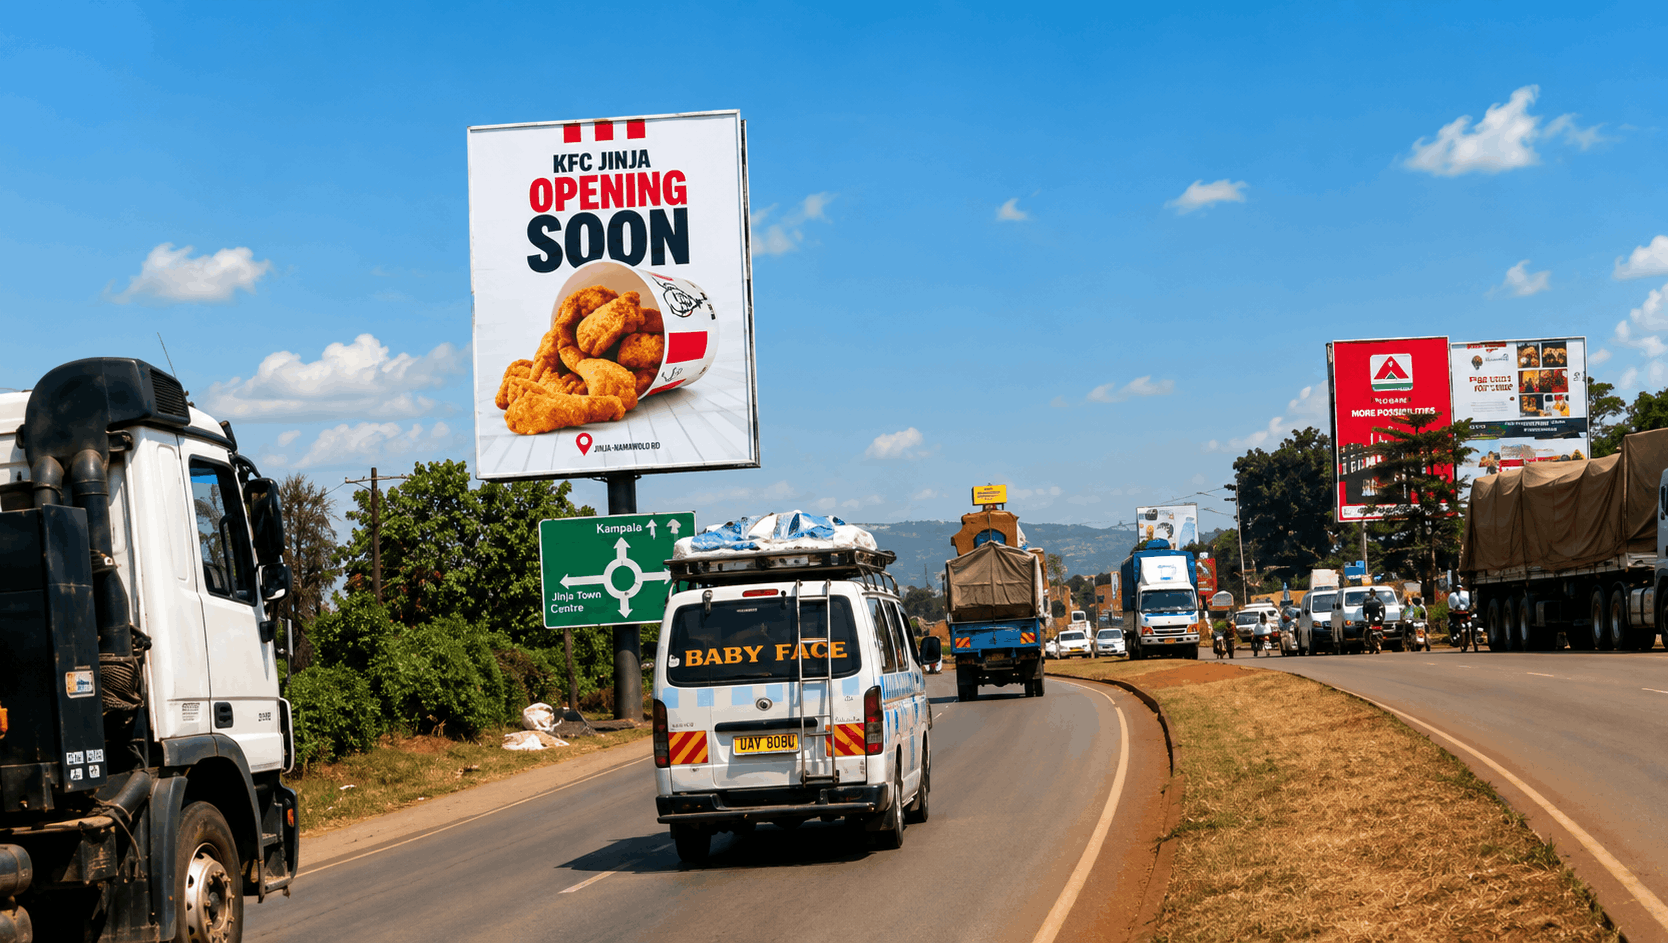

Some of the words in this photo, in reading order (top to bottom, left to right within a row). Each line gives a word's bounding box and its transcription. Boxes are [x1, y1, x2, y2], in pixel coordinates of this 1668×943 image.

[553, 152, 593, 174] KFC
[598, 149, 651, 171] JINJA
[529, 170, 688, 213] OPENING
[527, 207, 690, 274] SOON
[1351, 409, 1376, 418] MORE
[596, 523, 643, 535] Kampala
[551, 592, 574, 602] Jinja
[577, 591, 601, 600] Town
[550, 604, 584, 613] Centre
[685, 645, 764, 667] BABY
[775, 641, 847, 661] FACE
